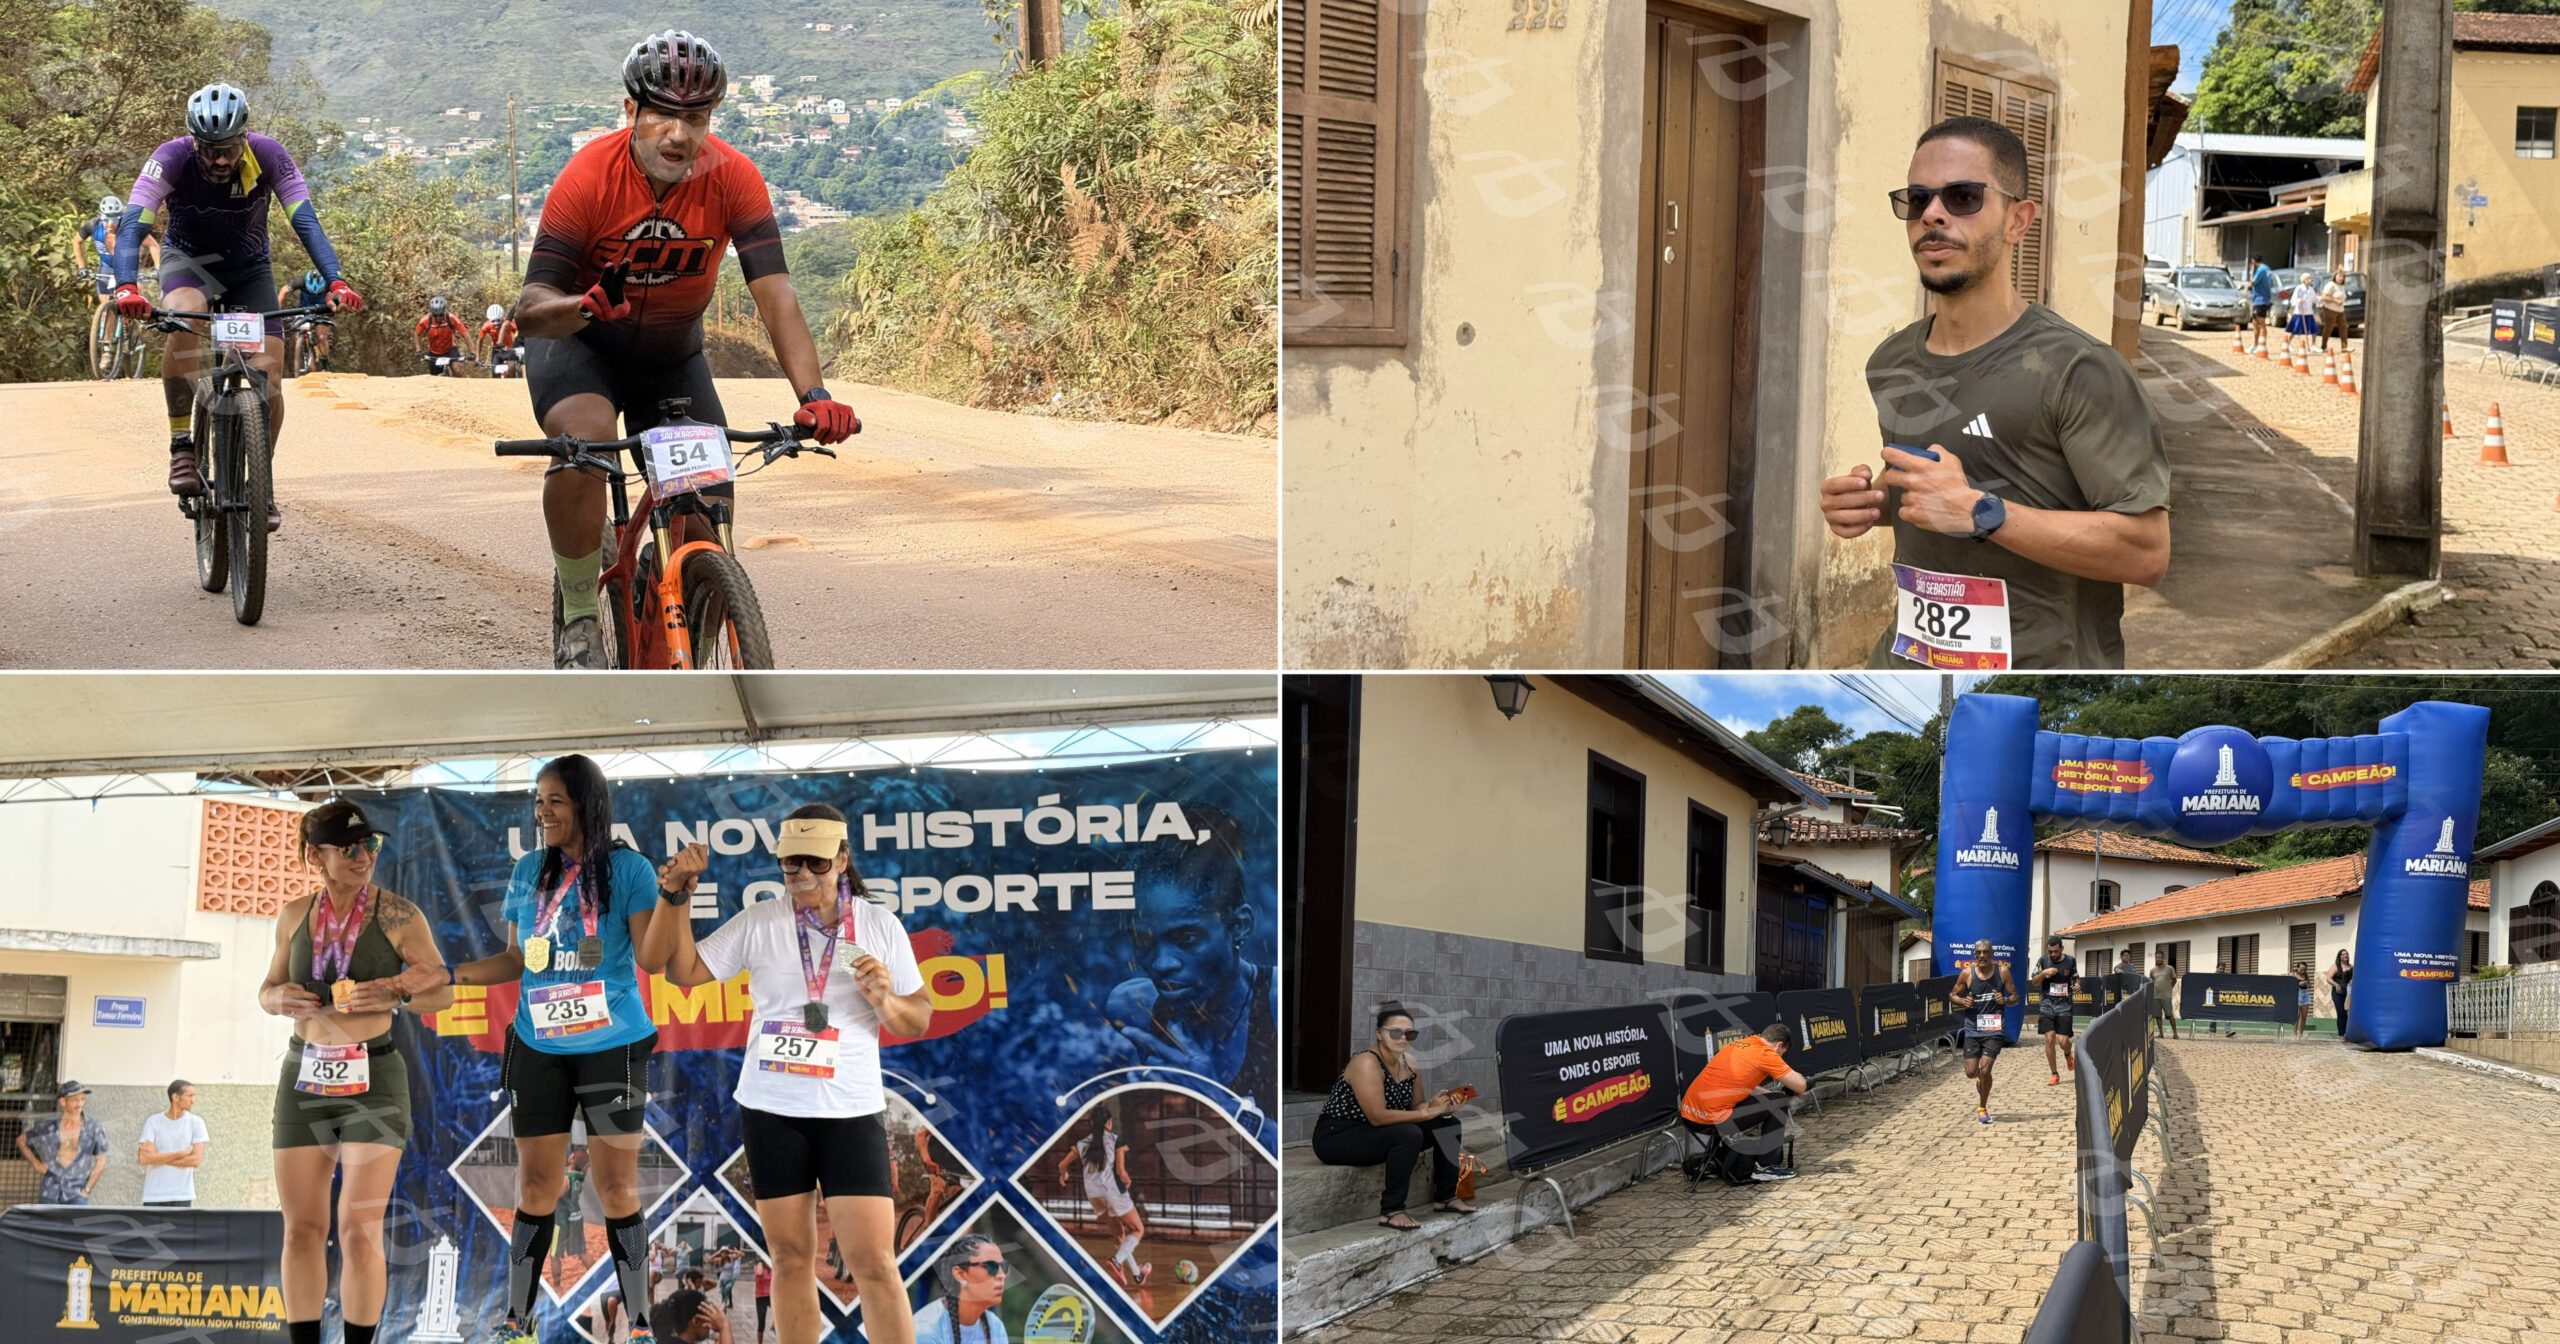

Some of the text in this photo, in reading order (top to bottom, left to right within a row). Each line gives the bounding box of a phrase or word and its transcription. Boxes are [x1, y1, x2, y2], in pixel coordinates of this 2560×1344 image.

[227, 321, 251, 336] 64
[669, 441, 709, 466] 54
[1915, 577, 1966, 597] SÃO SEBASTIÃO
[1913, 596, 1971, 640] 282
[2058, 759, 2118, 771] UMA NOVA
[2116, 775, 2148, 784] ONDE
[2292, 764, 2397, 787] É CAMPEÃO!
[2057, 781, 2122, 793] O ESPORTE
[2182, 795, 2260, 812] MARIANA
[665, 818, 780, 858] NOV
[863, 793, 1211, 851] HISTÓRIA,
[1956, 850, 2019, 866] MARIANA
[2405, 858, 2467, 875] MARIANA
[857, 871, 1136, 914] SPORTE
[2218, 993, 2275, 1004] MARIANA
[545, 998, 587, 1021] 235
[1810, 1019, 1847, 1039] MARIANA
[774, 1036, 818, 1058] 257
[1544, 1025, 1648, 1057] UMA NOVA HISTÓRIA,
[312, 1060, 348, 1080] 252
[1559, 1052, 1640, 1081] ONDE O ESPORTE
[1554, 1074, 1651, 1121] É CAMPEÃO!
[111, 1269, 203, 1283] PREFEITURA DE
[108, 1281, 287, 1320] MARIANA
[118, 1315, 281, 1331] CONSTRUINDO UMA NOVA HISTÓRIA!
